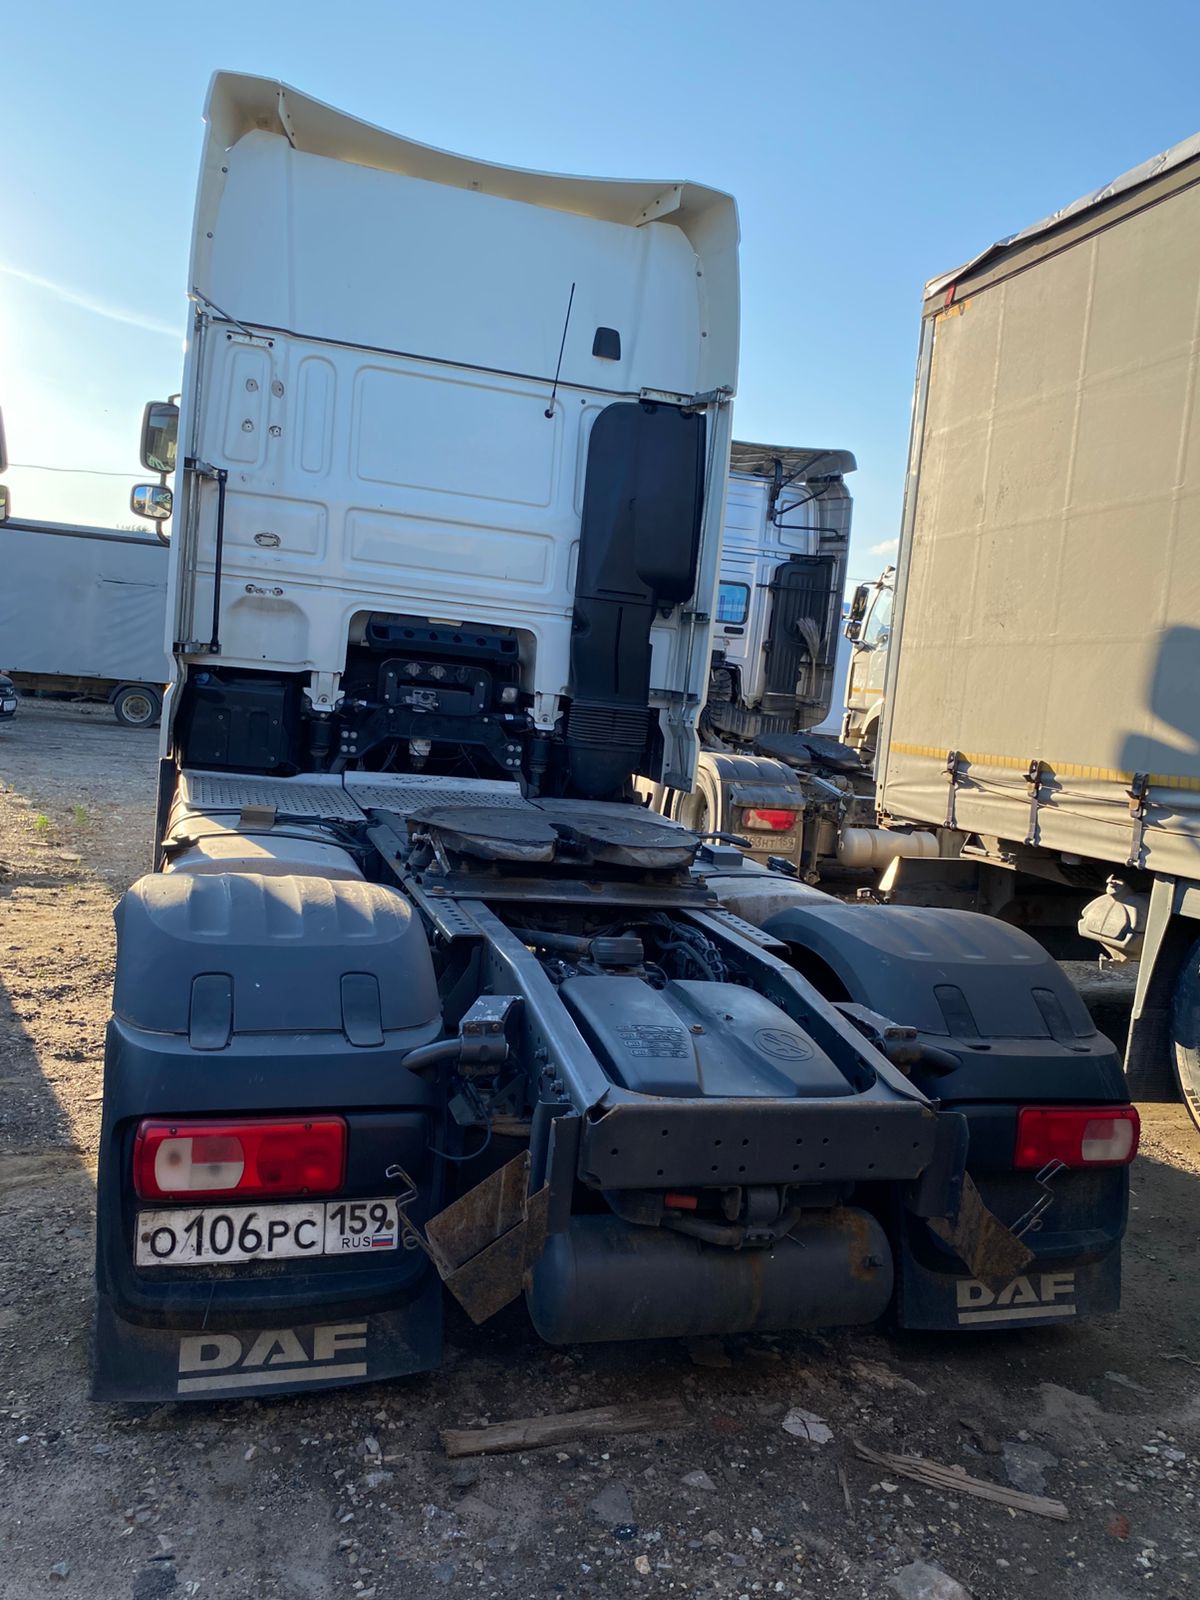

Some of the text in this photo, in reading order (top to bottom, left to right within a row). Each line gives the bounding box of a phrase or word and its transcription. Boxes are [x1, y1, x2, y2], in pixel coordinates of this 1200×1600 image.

[329, 1203, 389, 1236] 159
[342, 1236, 371, 1249] RUS
[956, 1272, 1075, 1308] DAF
[177, 1322, 368, 1372] DAF
